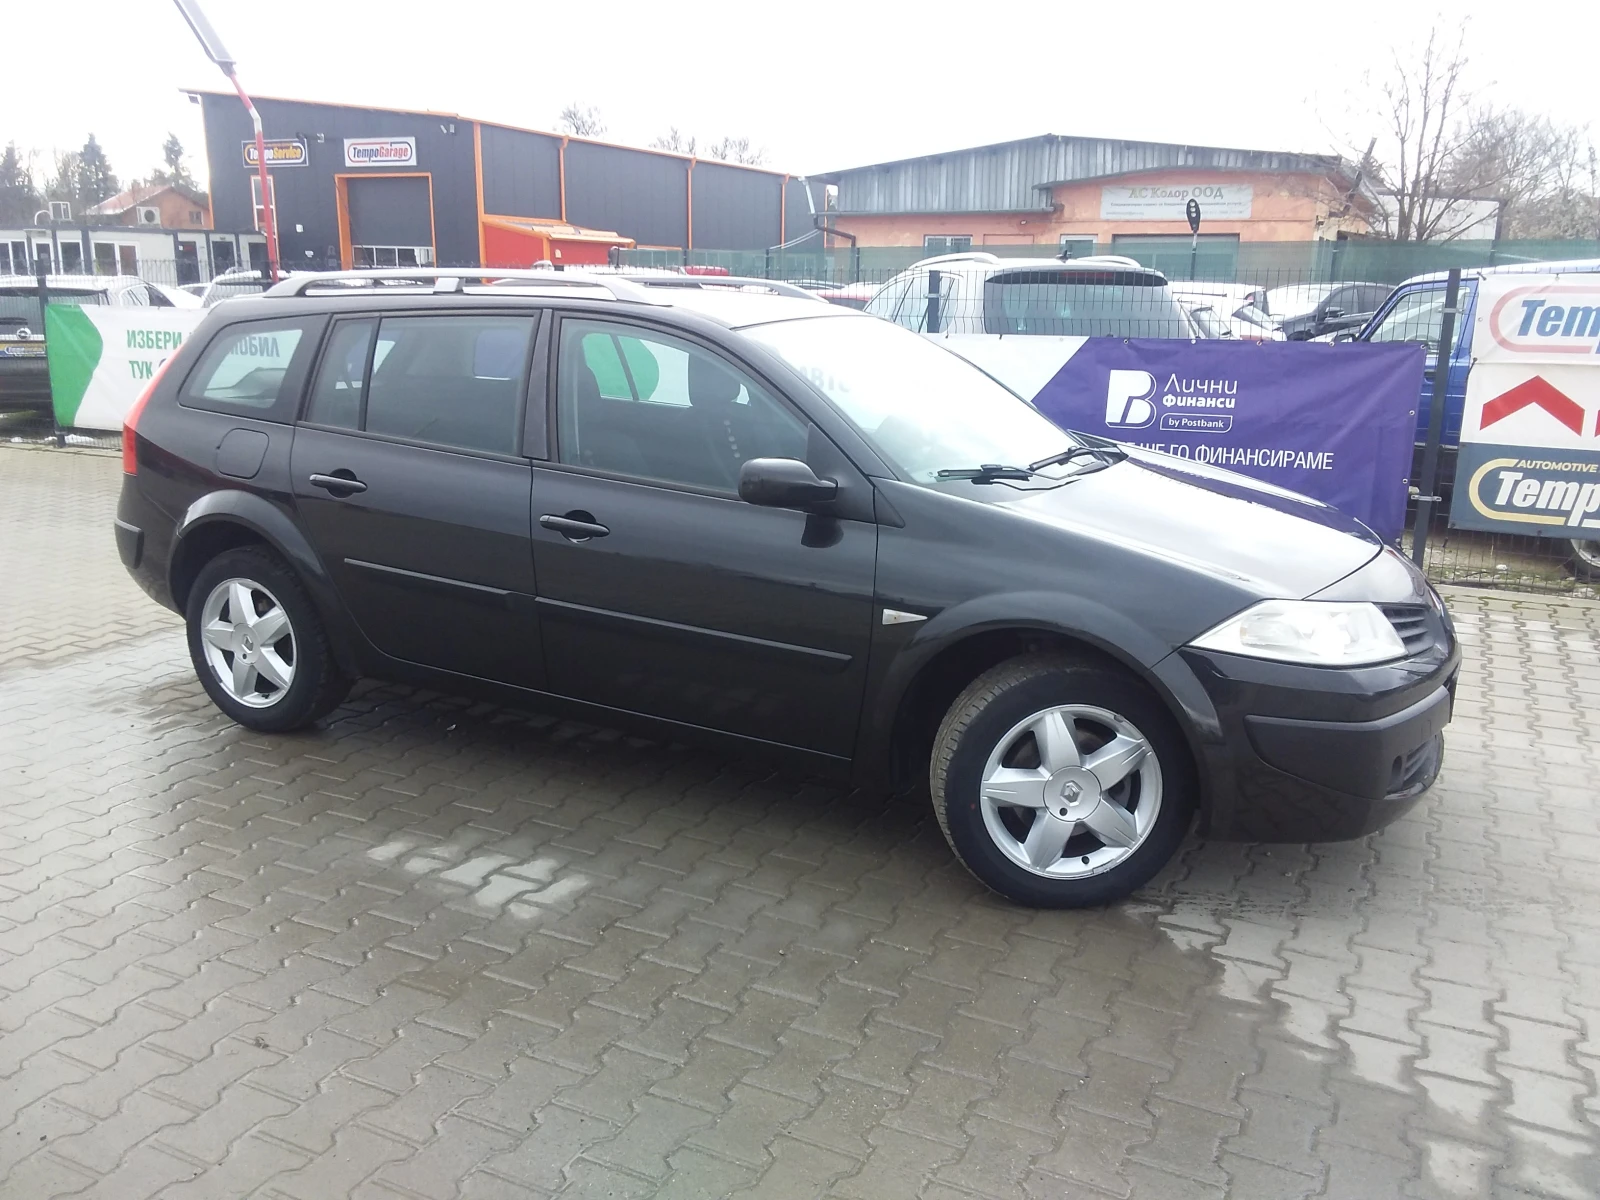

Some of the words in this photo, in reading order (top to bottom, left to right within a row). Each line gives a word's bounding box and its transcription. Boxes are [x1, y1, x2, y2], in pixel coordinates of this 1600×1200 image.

[249, 146, 302, 163] TepoService
[353, 145, 408, 162] TempoGarage
[1150, 186, 1189, 200] Колор
[1191, 186, 1224, 199] ООД
[1517, 298, 1600, 354] Tem
[126, 329, 182, 350] ИЗБЕРИ
[128, 360, 153, 379] ТУК
[1163, 373, 1238, 395] Лични
[1168, 417, 1180, 428] by
[1181, 417, 1224, 428] Postbank
[1194, 444, 1334, 470] ФИНАНСИРАМЕ
[1516, 460, 1599, 473] AUTOMOTIVE
